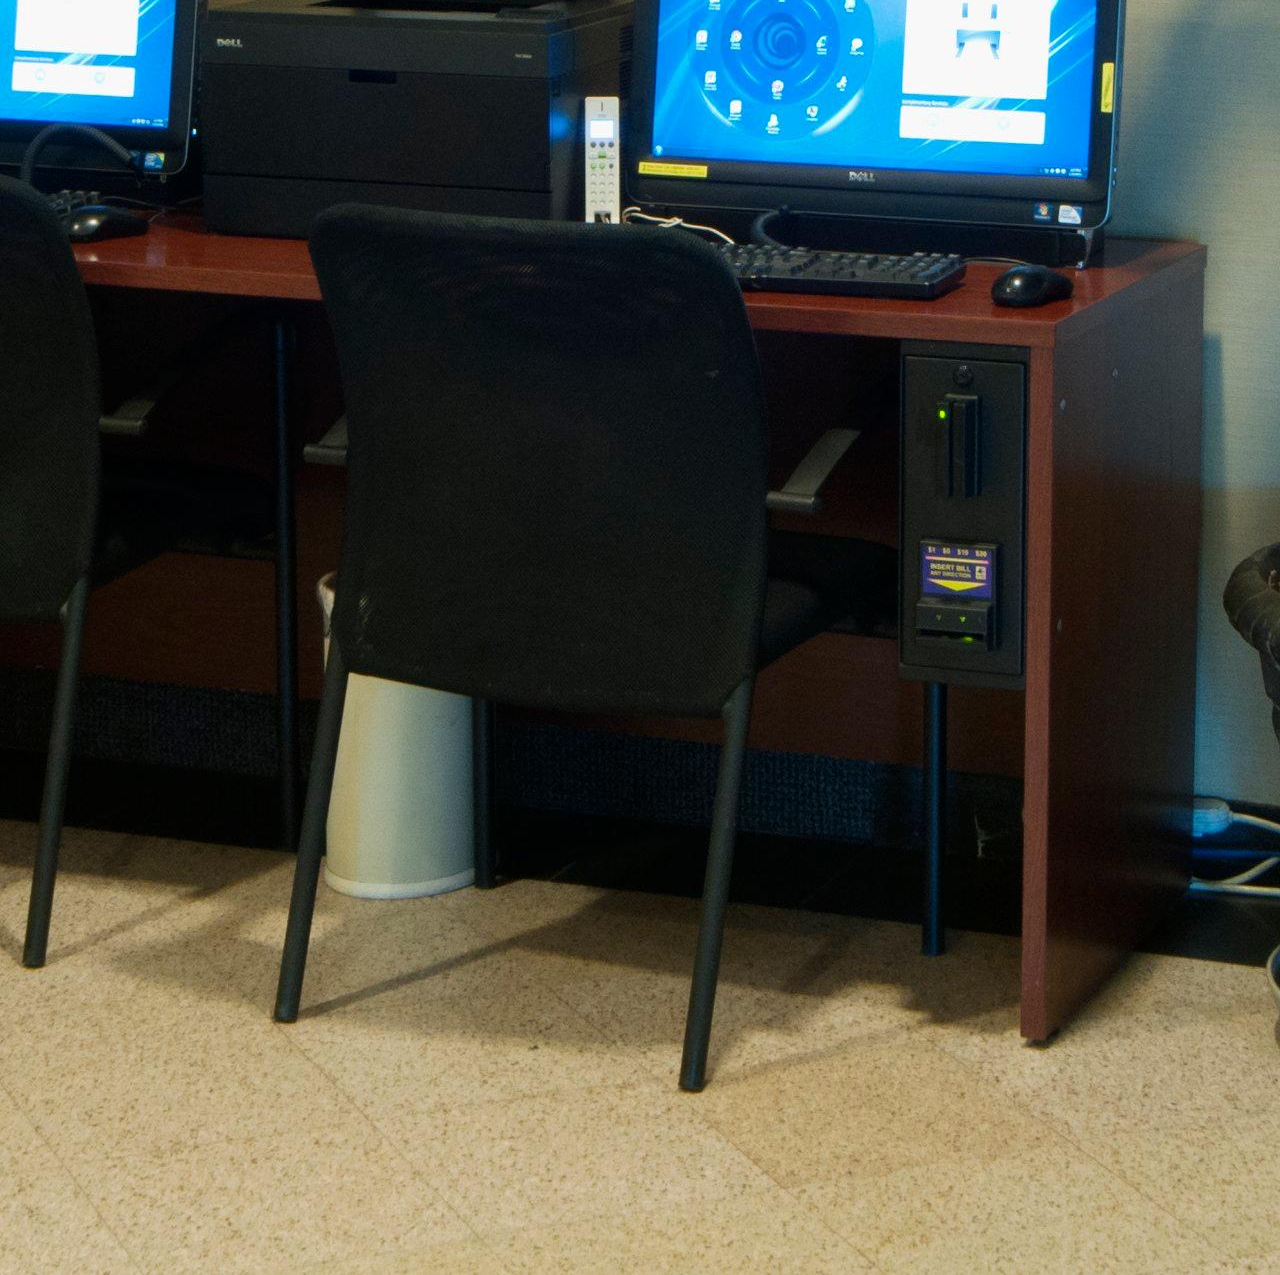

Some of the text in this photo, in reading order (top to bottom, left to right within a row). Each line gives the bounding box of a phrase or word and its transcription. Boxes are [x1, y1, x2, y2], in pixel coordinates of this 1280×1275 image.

[217, 38, 243, 48] DELL
[848, 171, 875, 183] DELL
[930, 563, 971, 574] INSERT BILL
